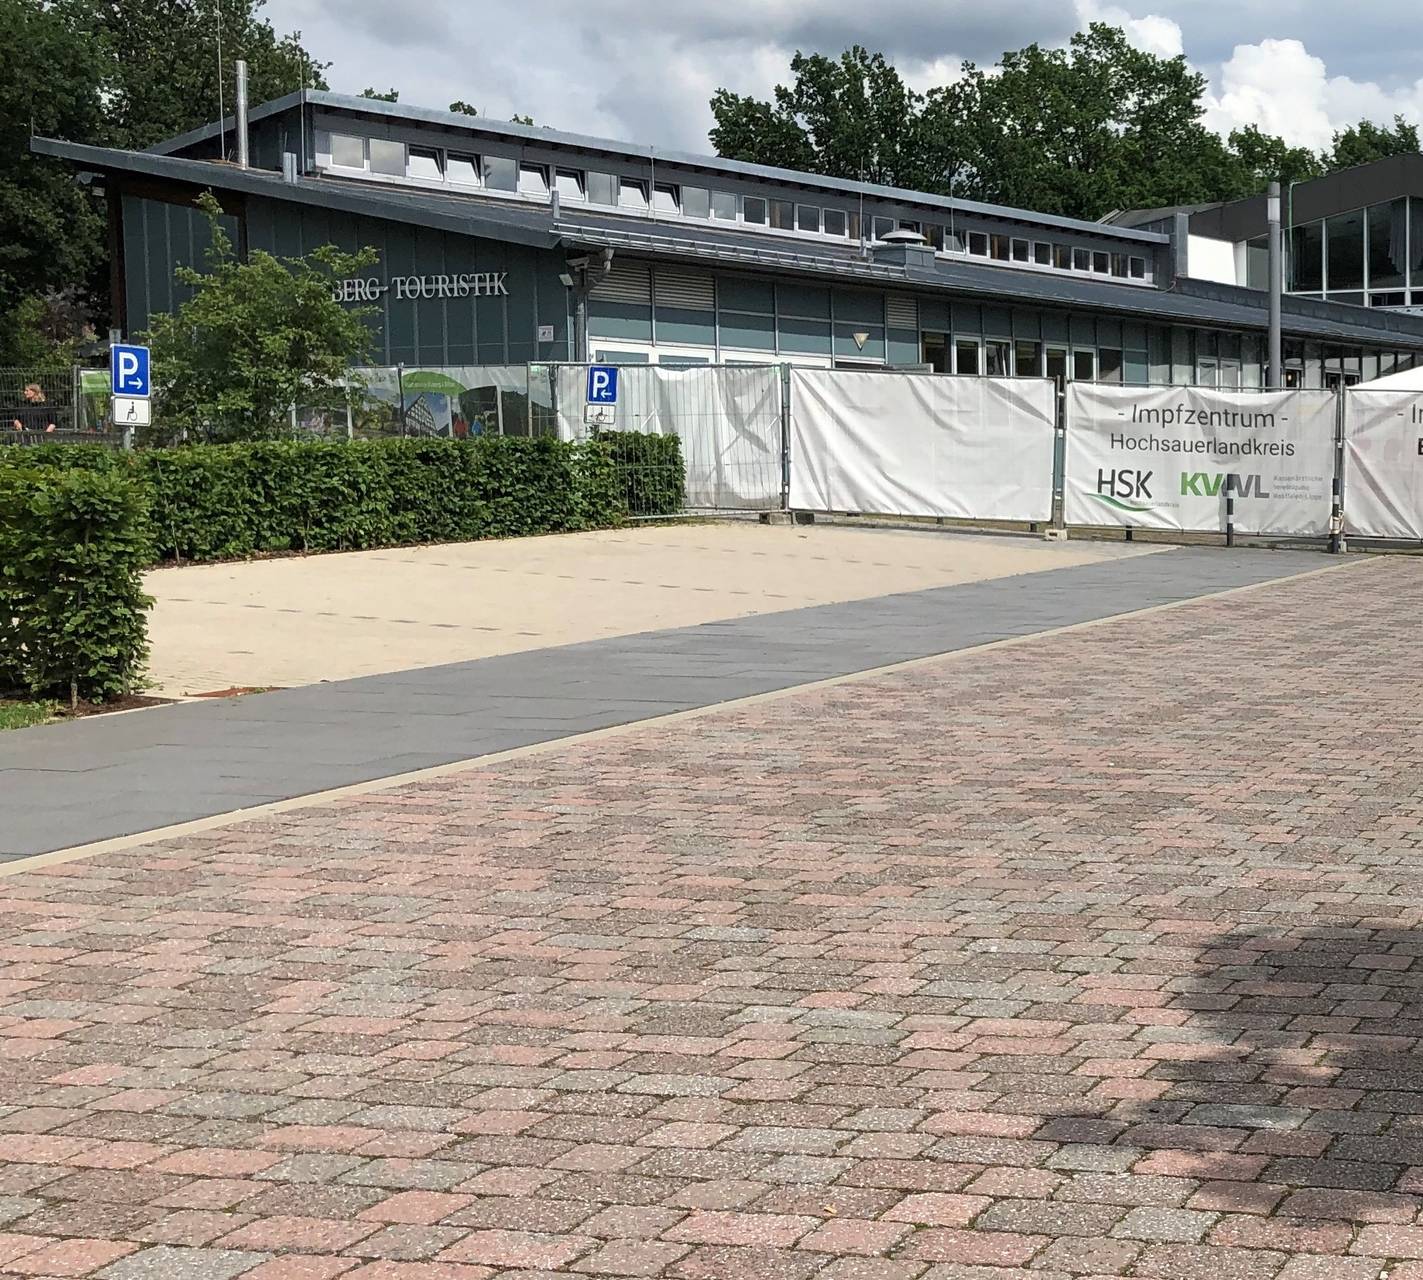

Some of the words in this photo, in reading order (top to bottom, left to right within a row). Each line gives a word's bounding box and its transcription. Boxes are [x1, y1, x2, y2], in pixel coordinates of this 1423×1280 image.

[118, 351, 139, 389] P
[593, 370, 610, 399] P
[1131, 404, 1275, 429] Impfzentrum
[1110, 433, 1296, 457] Hochsauerlandkreis
[1097, 468, 1154, 499] HSK
